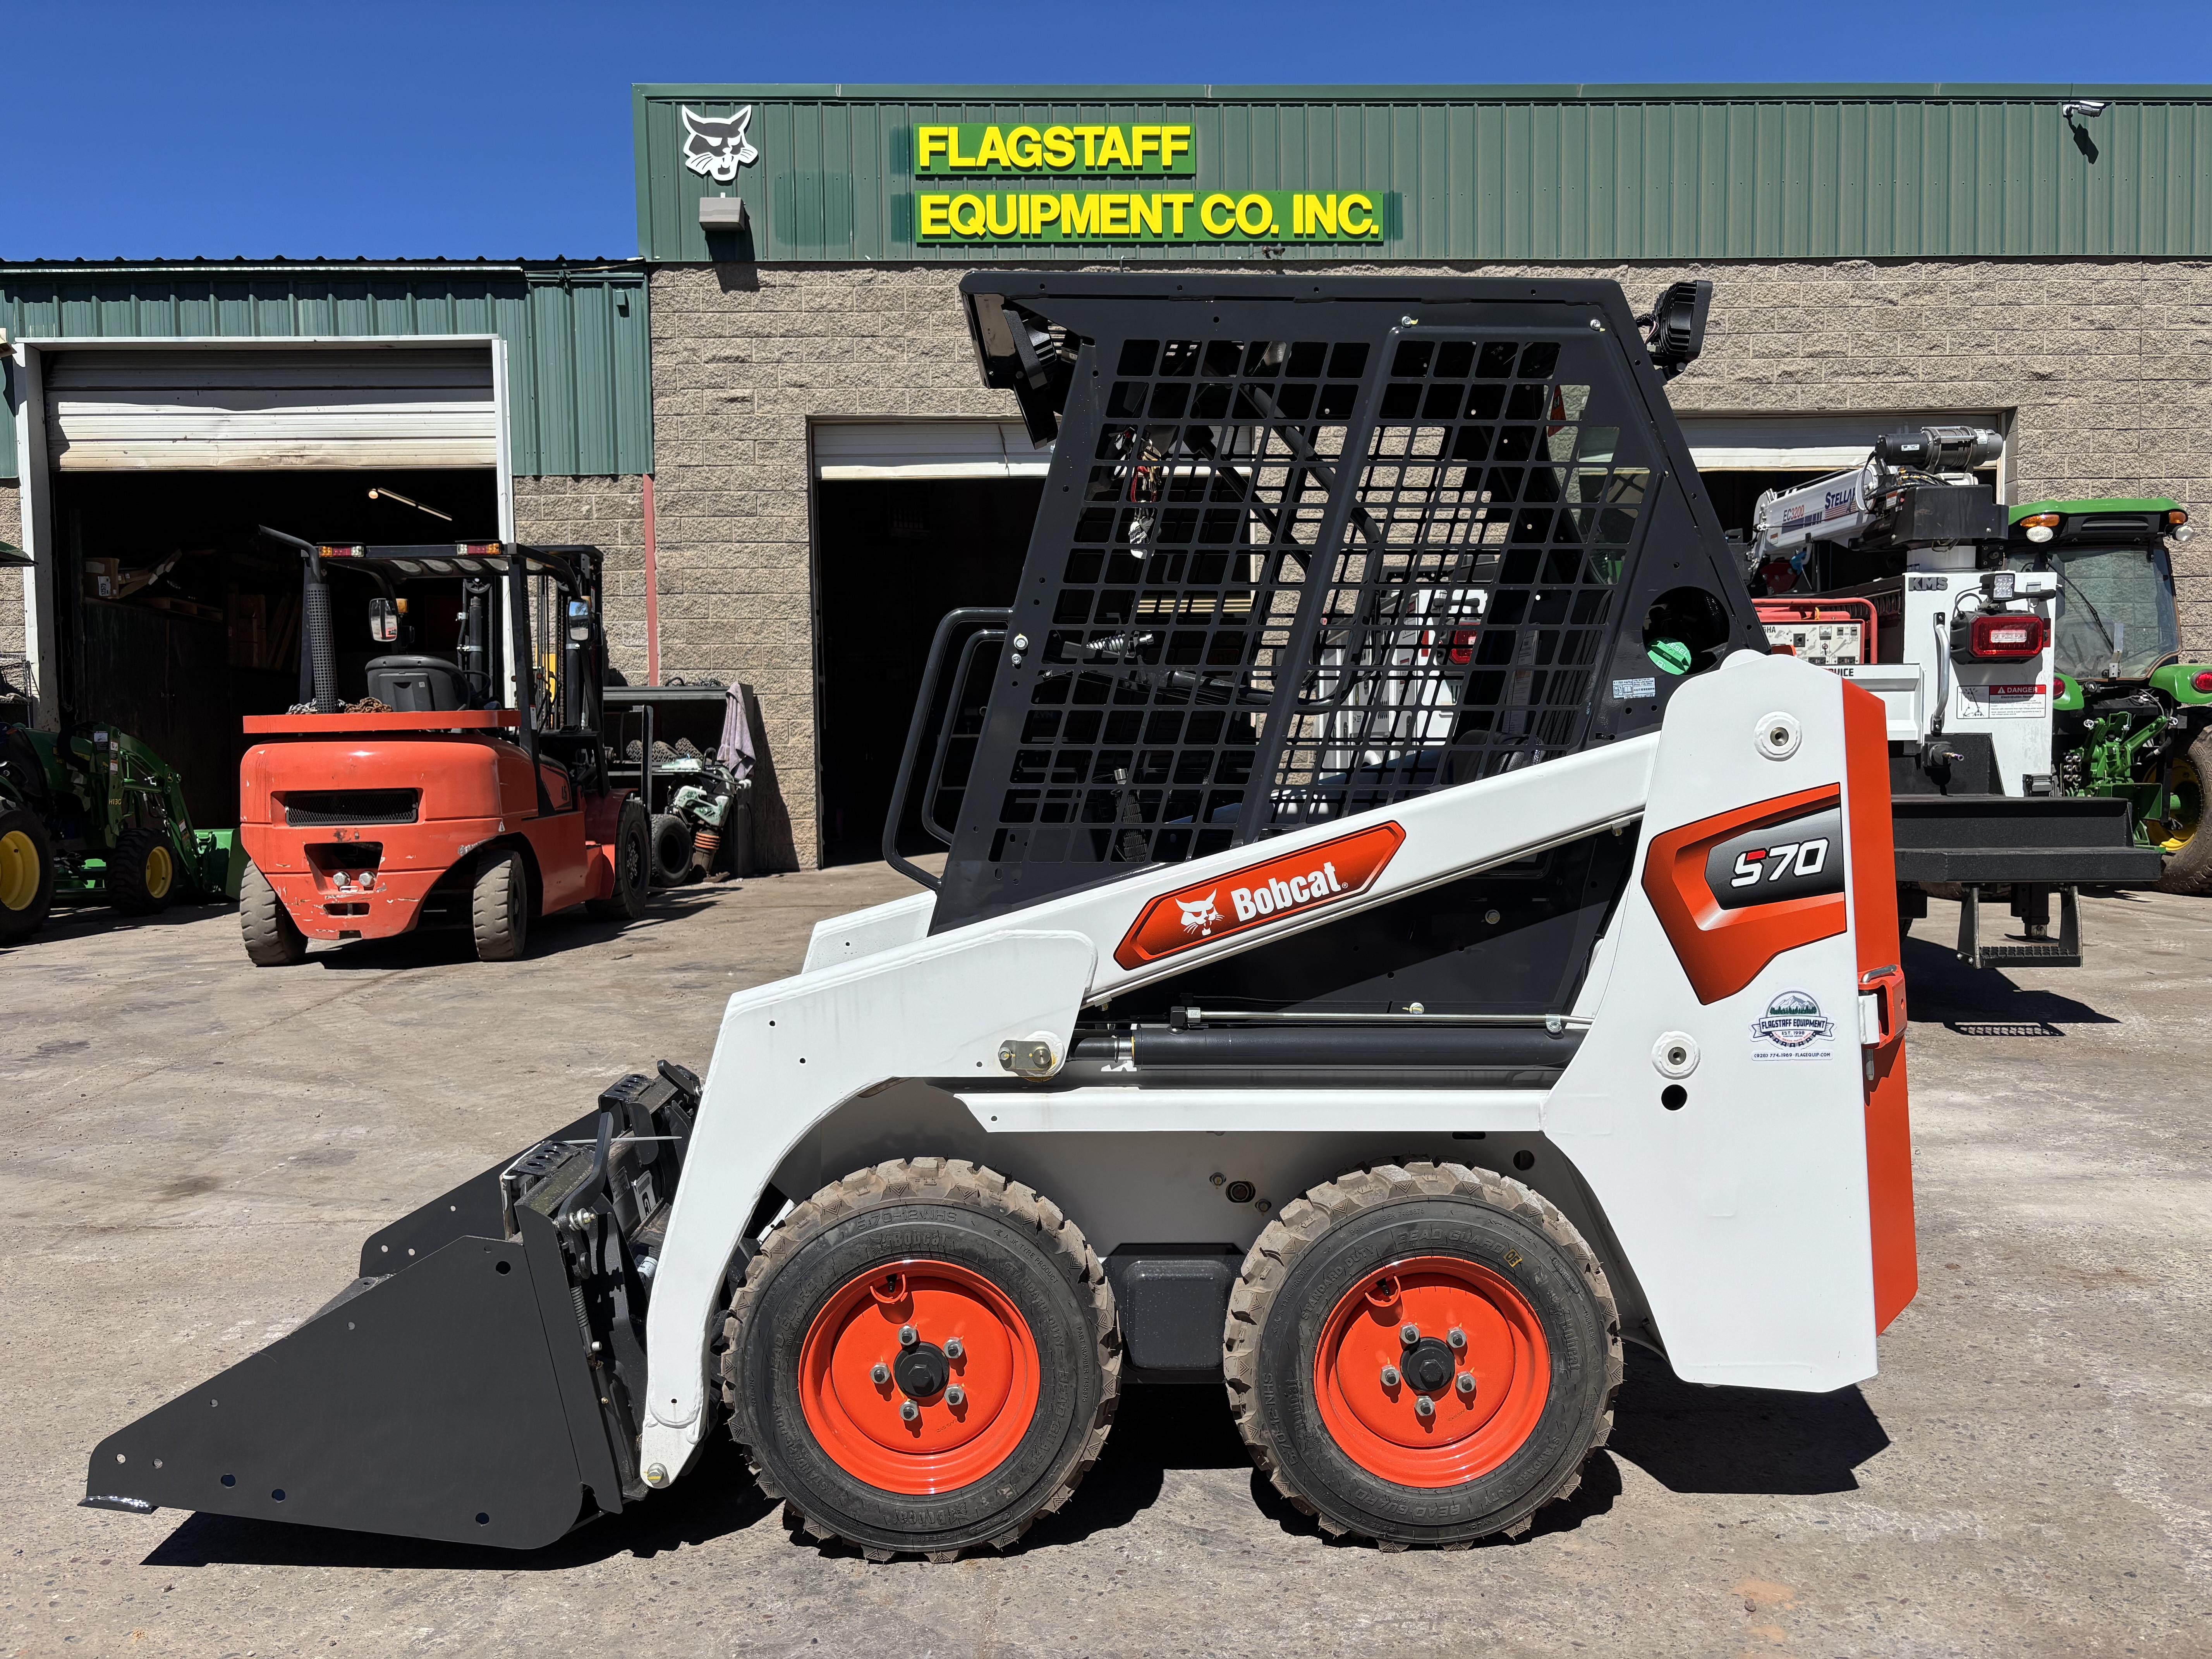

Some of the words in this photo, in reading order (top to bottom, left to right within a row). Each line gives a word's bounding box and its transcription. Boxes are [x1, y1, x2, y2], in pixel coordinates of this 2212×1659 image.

[919, 126, 1190, 167] FLAGSTAFF
[921, 194, 1194, 235] EQUIPMENT
[1201, 194, 1279, 234] CO.
[1293, 194, 1379, 234] INC.
[1783, 505, 1804, 522] EC3200
[1908, 577, 1948, 591] KMS
[1730, 838, 1829, 888] S70
[1231, 862, 1342, 922] Bobcat
[1762, 1019, 1792, 1029] FLAGSTAFF
[1793, 1019, 1826, 1029] EQUIPMENT
[924, 1208, 957, 1222] NHS
[1350, 1223, 1367, 1235] PART
[893, 1230, 946, 1247] Bobcat
[1397, 1229, 1443, 1245] BEAD
[1448, 1230, 1505, 1255] GUARD
[1020, 1243, 1036, 1259] TYRE
[1035, 1257, 1059, 1284] PRODUCT
[1281, 1290, 1293, 1309] TYRE
[1291, 1262, 1314, 1290] PRODUCT
[1301, 1266, 1345, 1320] STANDARD
[1345, 1244, 1374, 1267] DUTY
[1003, 1261, 1049, 1314] STANDARD
[1048, 1315, 1065, 1347] DUTY
[1076, 1326, 1085, 1343] PART
[1081, 1345, 1089, 1374] NUMBER
[1263, 1373, 1275, 1405] NHS
[1515, 1436, 1560, 1487] STANDARD
[1413, 1504, 1461, 1518] BEAD
[1484, 1484, 1514, 1506] DUTY
